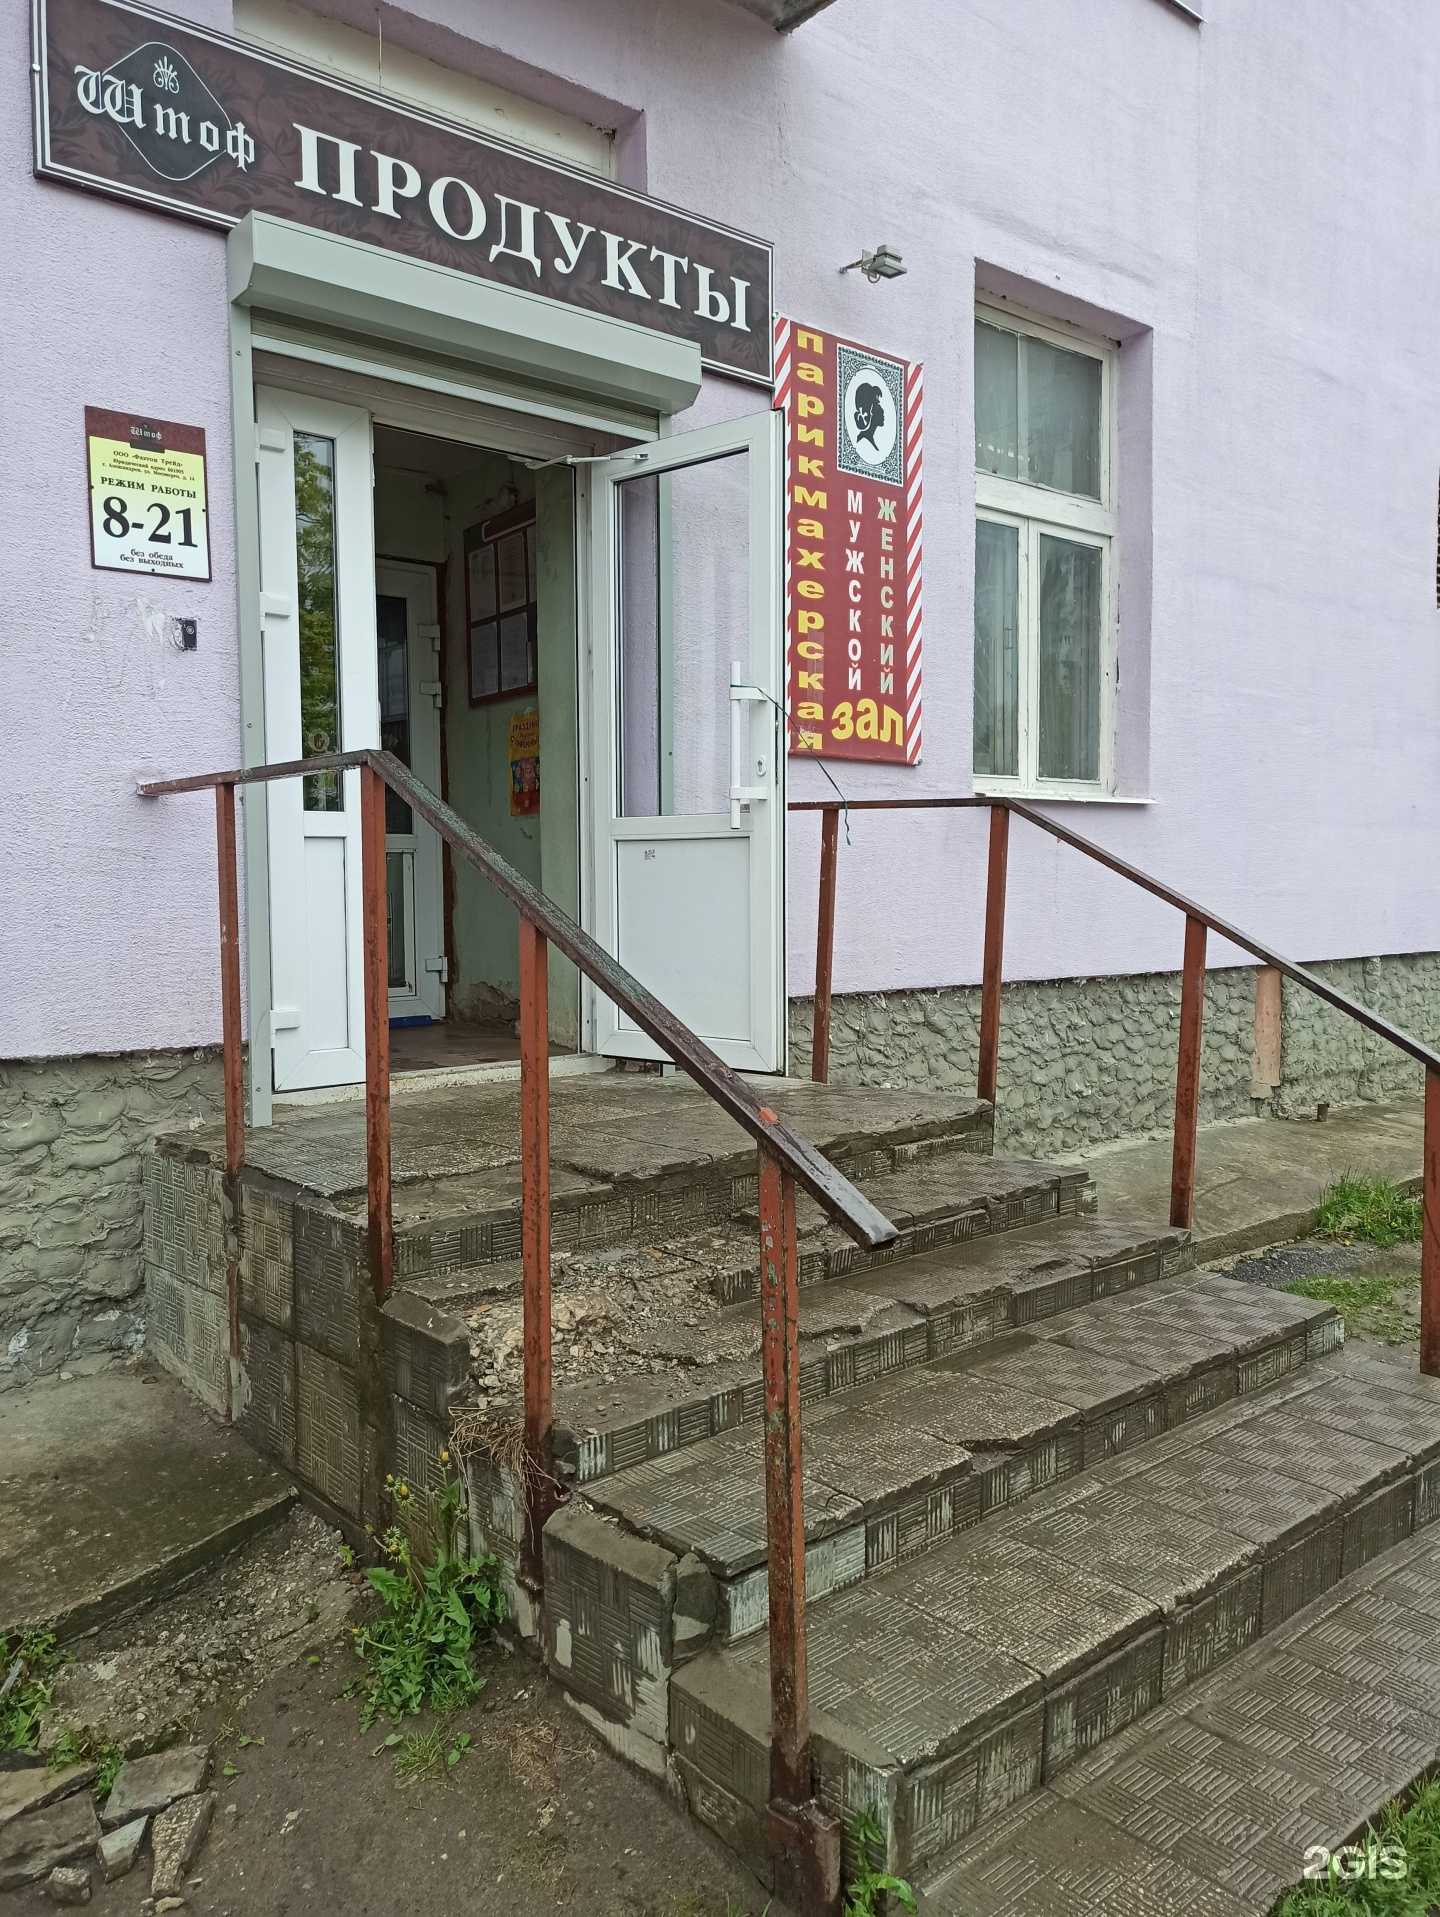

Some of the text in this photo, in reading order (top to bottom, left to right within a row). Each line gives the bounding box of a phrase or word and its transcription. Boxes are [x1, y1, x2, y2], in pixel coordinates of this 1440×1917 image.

[74, 65, 255, 172] Штоф
[292, 123, 752, 332] ПРОДУКТЫ
[100, 476, 196, 499] РЕЖИМ РАБОТЫ
[103, 496, 198, 548] 8-21
[120, 554, 184, 568] без выходных
[130, 548, 173, 560] без обеда
[845, 489, 865, 691] МУЖСКОЙ
[877, 496, 897, 695] ЖЕНСКИЙ
